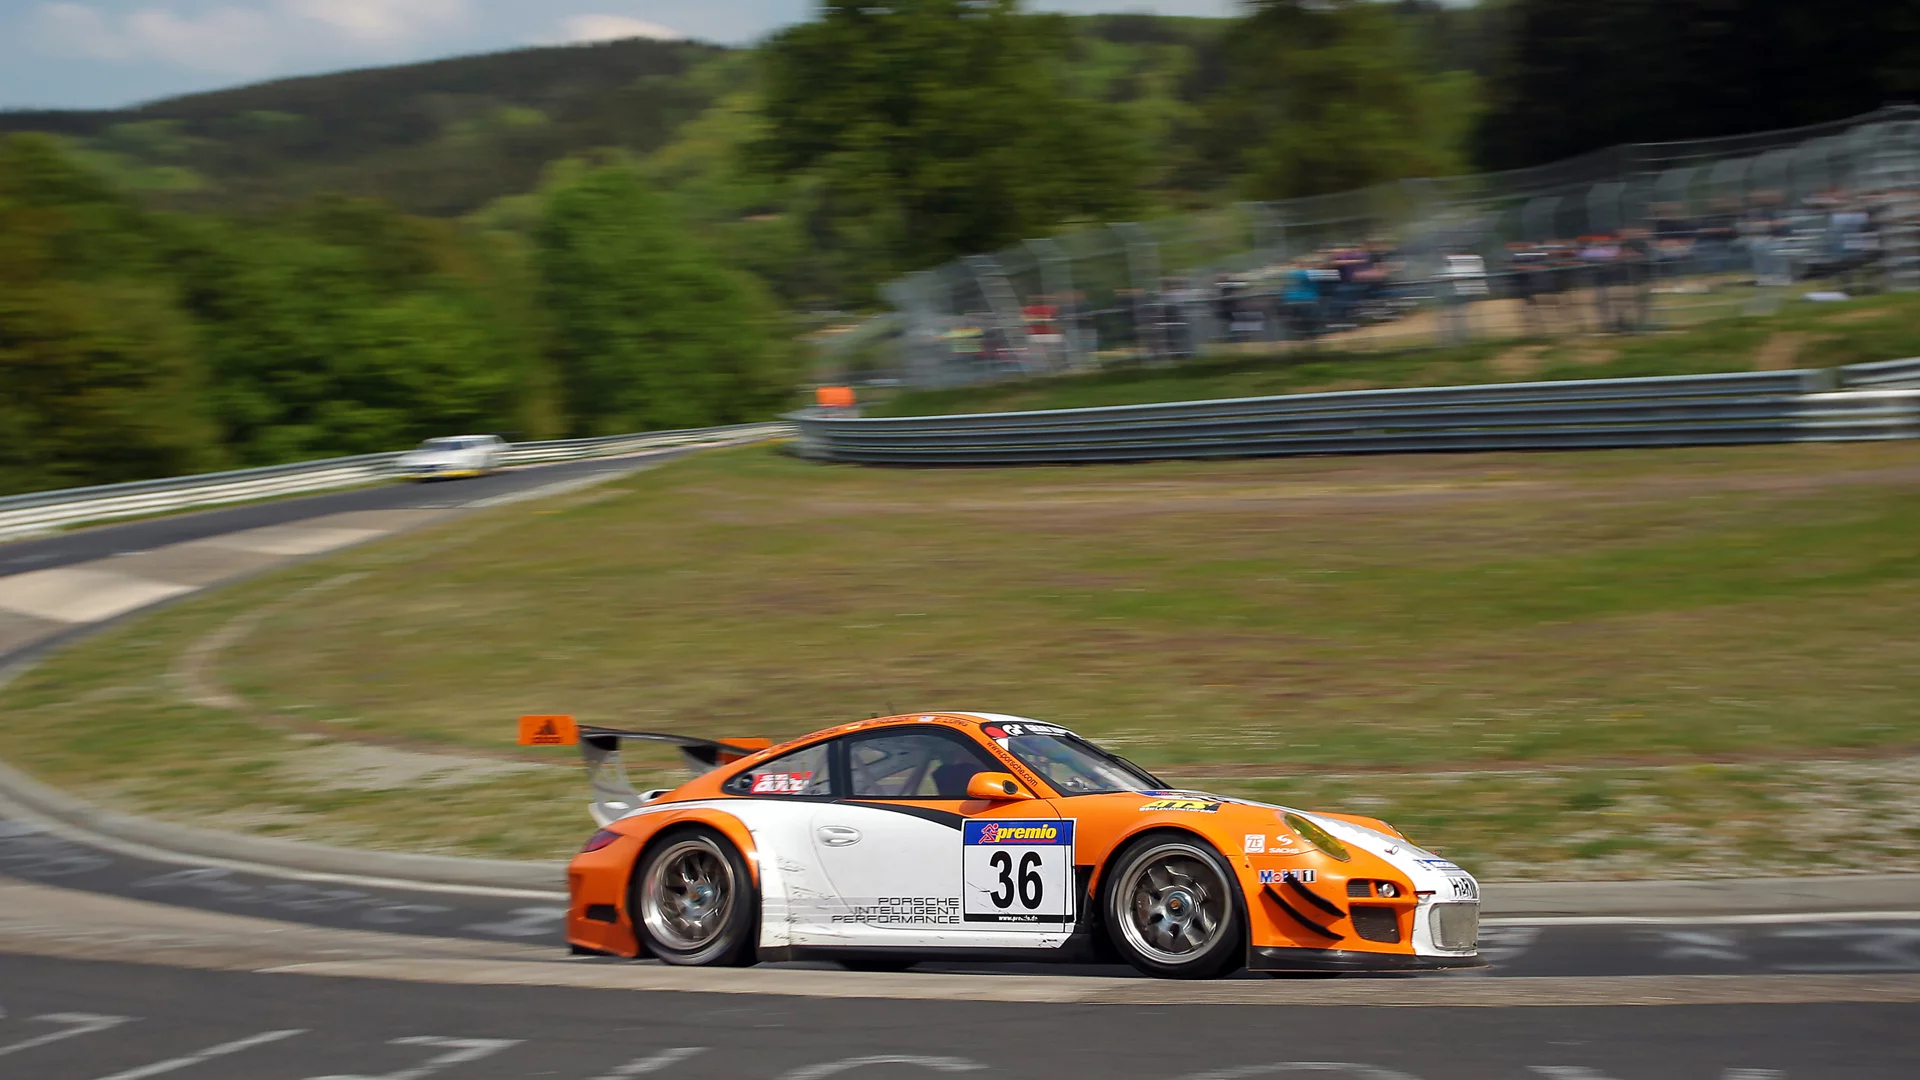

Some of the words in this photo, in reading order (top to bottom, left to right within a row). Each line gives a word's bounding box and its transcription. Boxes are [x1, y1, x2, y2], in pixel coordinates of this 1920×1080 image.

[987, 742, 1038, 787] www.porsche.com
[995, 824, 1058, 843] premio
[989, 850, 1044, 910] 36
[878, 897, 960, 906] PORSCHE
[854, 906, 960, 915] INTELLIGENT
[831, 915, 960, 924] PERFORMANCE
